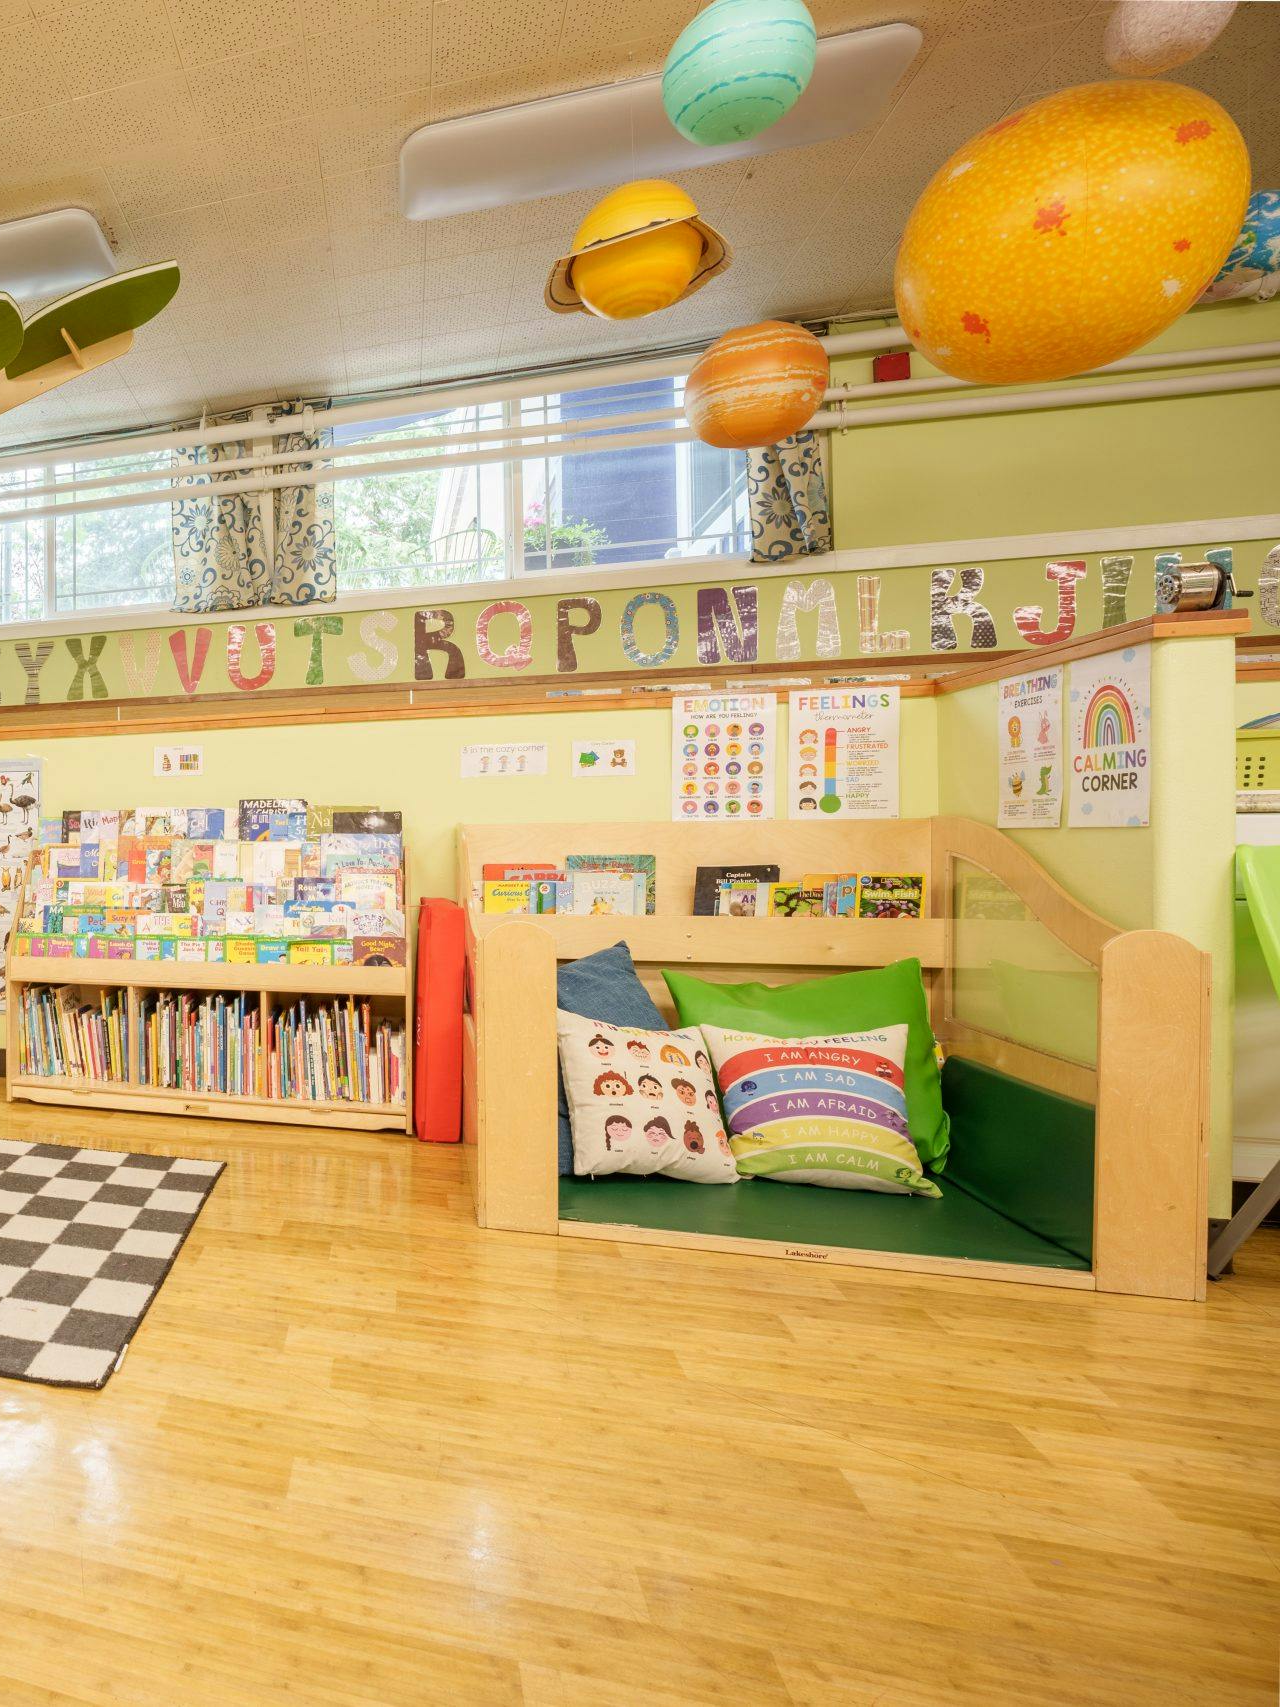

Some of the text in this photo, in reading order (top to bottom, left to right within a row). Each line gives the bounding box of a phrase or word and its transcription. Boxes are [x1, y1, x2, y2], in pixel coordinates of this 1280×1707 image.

[14, 642, 54, 705] Y
[65, 635, 108, 700] X
[120, 631, 160, 694] W
[168, 628, 213, 693] V
[227, 623, 277, 691] U
[294, 616, 343, 685] T
[347, 611, 398, 681] S
[414, 609, 466, 680] R
[476, 601, 533, 670] Q
[557, 597, 602, 672] P
[620, 592, 679, 667] O
[697, 585, 758, 665] N
[776, 579, 841, 660] M
[857, 575, 910, 653] L
[931, 567, 998, 650] K
[1013, 560, 1087, 646] J
[1100, 555, 1135, 629] I
[1003, 674, 1057, 699] BREATHING
[683, 698, 765, 712] EMOTION
[798, 694, 890, 710] FEELINGS
[1014, 695, 1043, 709] EXERCISES
[463, 746, 468, 754] 3
[470, 746, 478, 754] in
[496, 746, 515, 754] cozy
[1074, 749, 1147, 773] CALMING
[1082, 772, 1138, 792] CORNER
[864, 888, 918, 899] Swim, Fish!
[723, 1034, 757, 1042] HOW
[824, 1034, 888, 1045] FEELING
[764, 1050, 861, 1066] I AM ANGRY
[777, 1071, 856, 1087] I AM SAD
[770, 1099, 877, 1119] I AM AFRAID
[781, 1124, 879, 1143] I AM HAPPY
[788, 1153, 880, 1171] I AM CALM
[785, 1249, 827, 1259] Lakeshore
